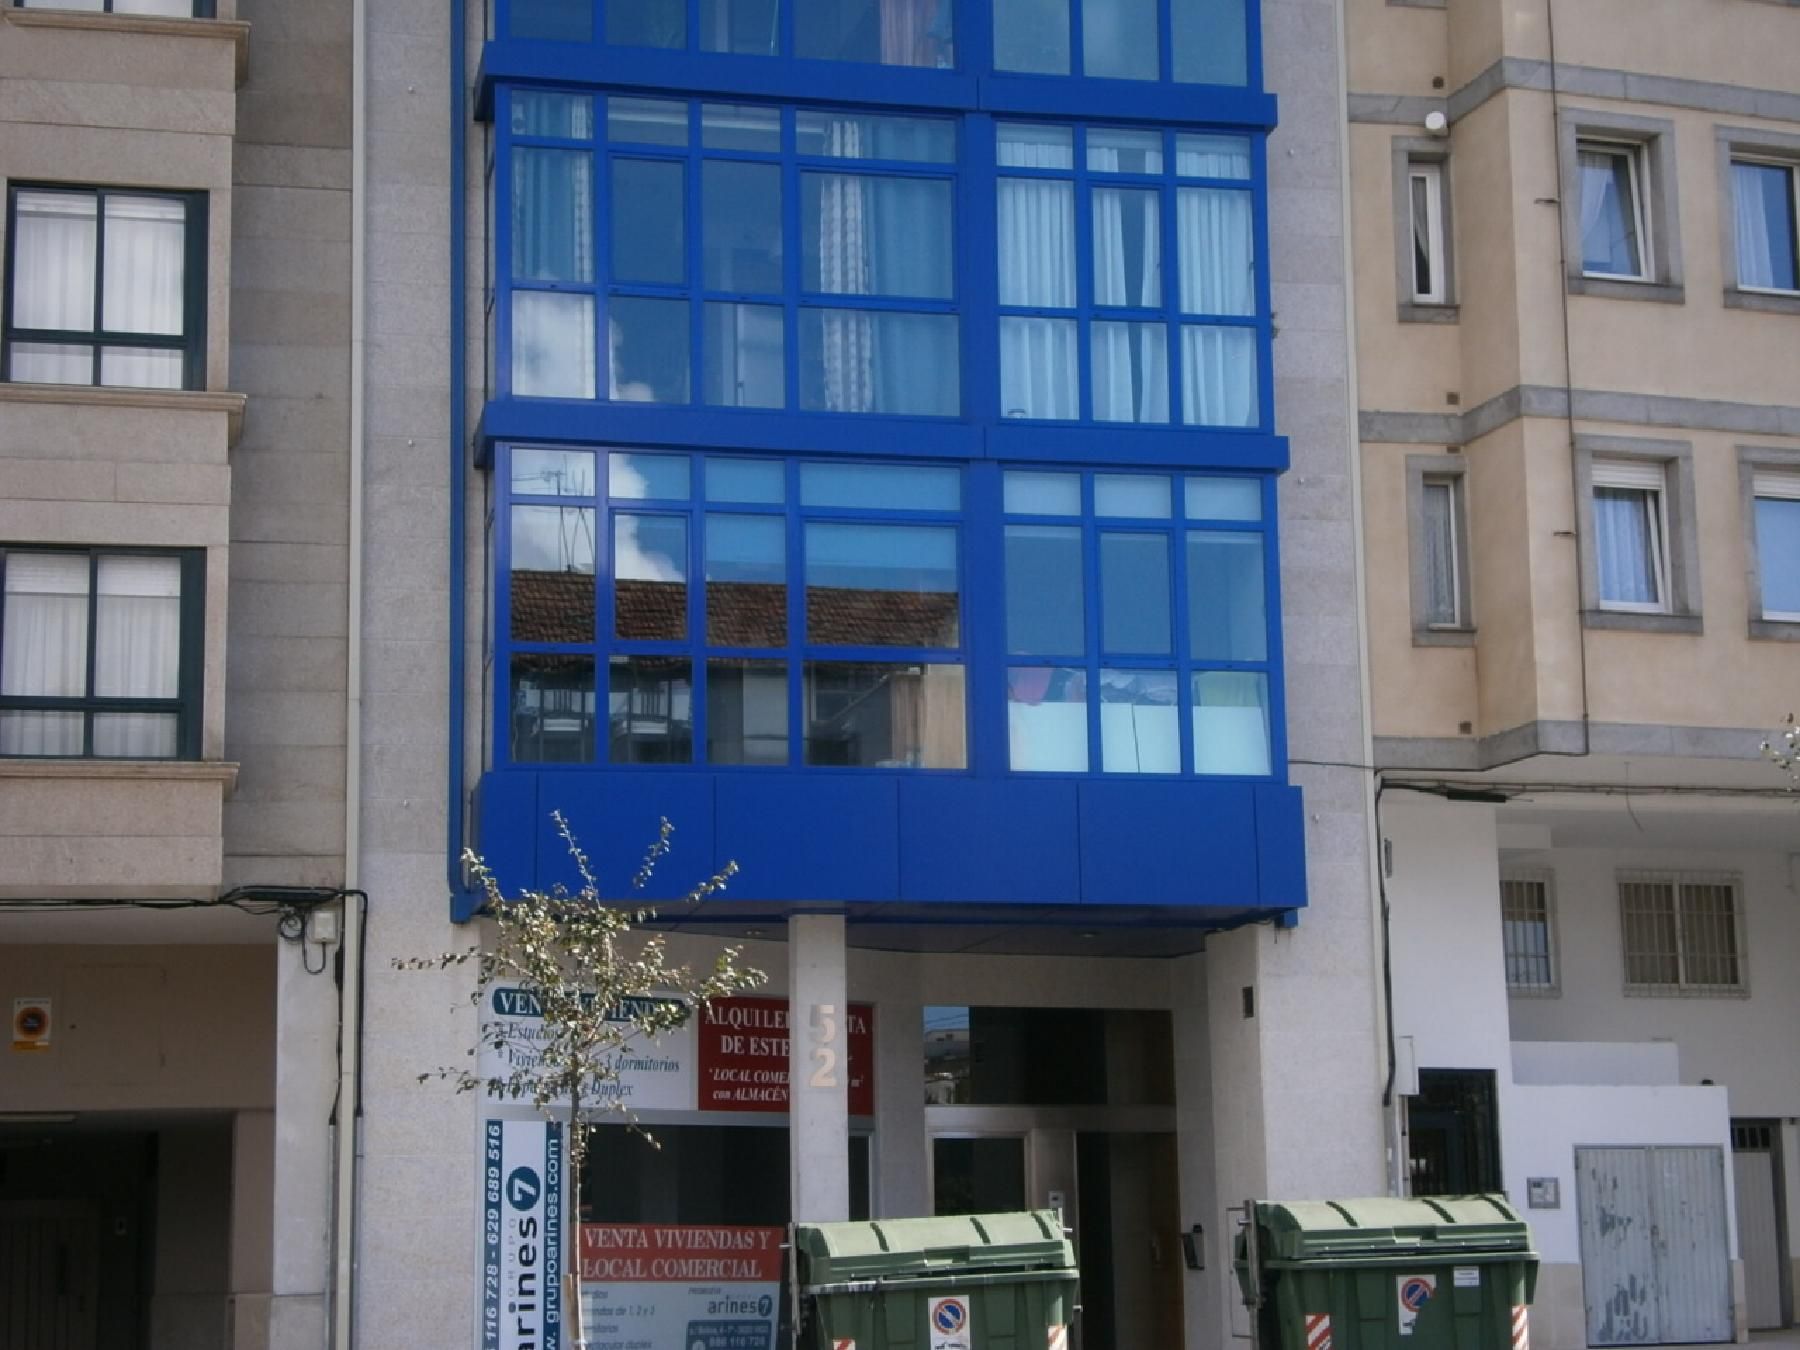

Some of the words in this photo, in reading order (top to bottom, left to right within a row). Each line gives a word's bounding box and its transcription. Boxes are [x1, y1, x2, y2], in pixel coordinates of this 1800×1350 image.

[720, 1035, 745, 1054] DE
[614, 1055, 680, 1073] dormitorios
[488, 1124, 501, 1160] 516
[488, 1167, 500, 1203] 689
[487, 1209, 499, 1245] 629
[585, 1228, 649, 1248] VENTA
[654, 1229, 754, 1250] VIVIENDAS
[758, 1231, 771, 1250] Y
[583, 1258, 646, 1278] LOCAL
[652, 1258, 762, 1279] COMERCIAL
[486, 1265, 498, 1299] 728
[708, 1295, 757, 1314] arines
